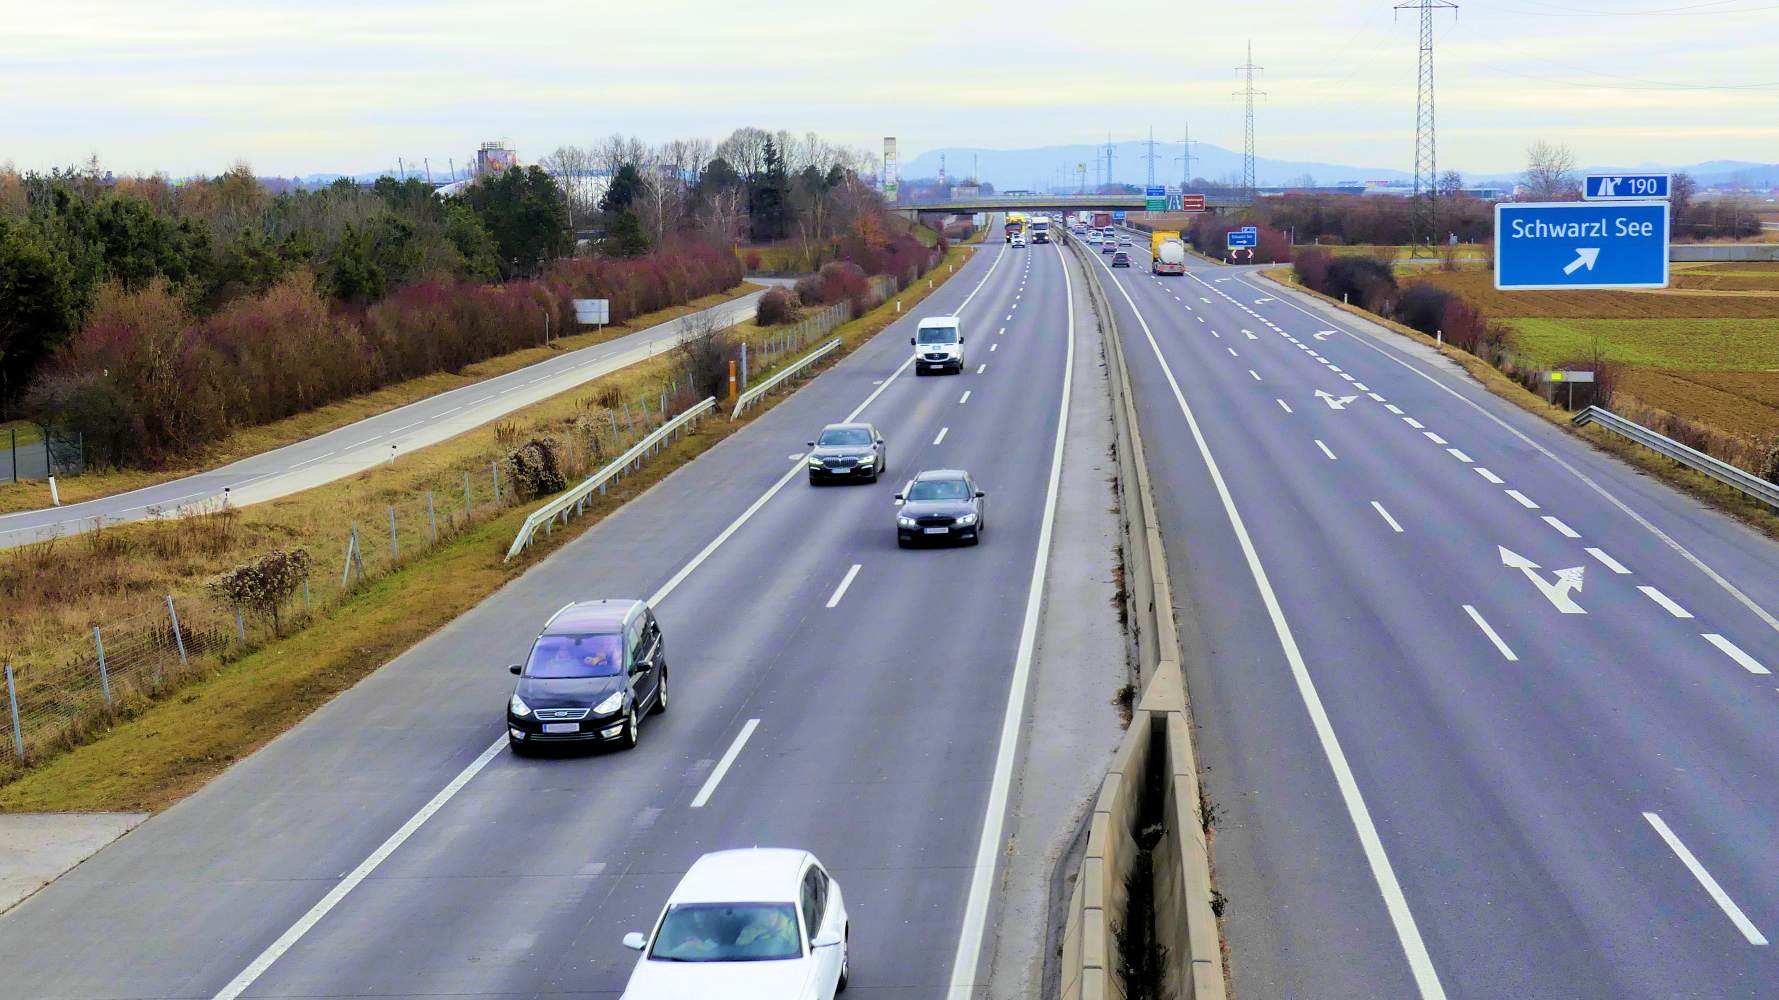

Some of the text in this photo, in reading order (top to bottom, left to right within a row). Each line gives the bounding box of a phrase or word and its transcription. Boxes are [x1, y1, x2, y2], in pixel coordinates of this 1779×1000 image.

[1628, 178, 1657, 194] 190
[1511, 217, 1653, 238] Schwarzl See
